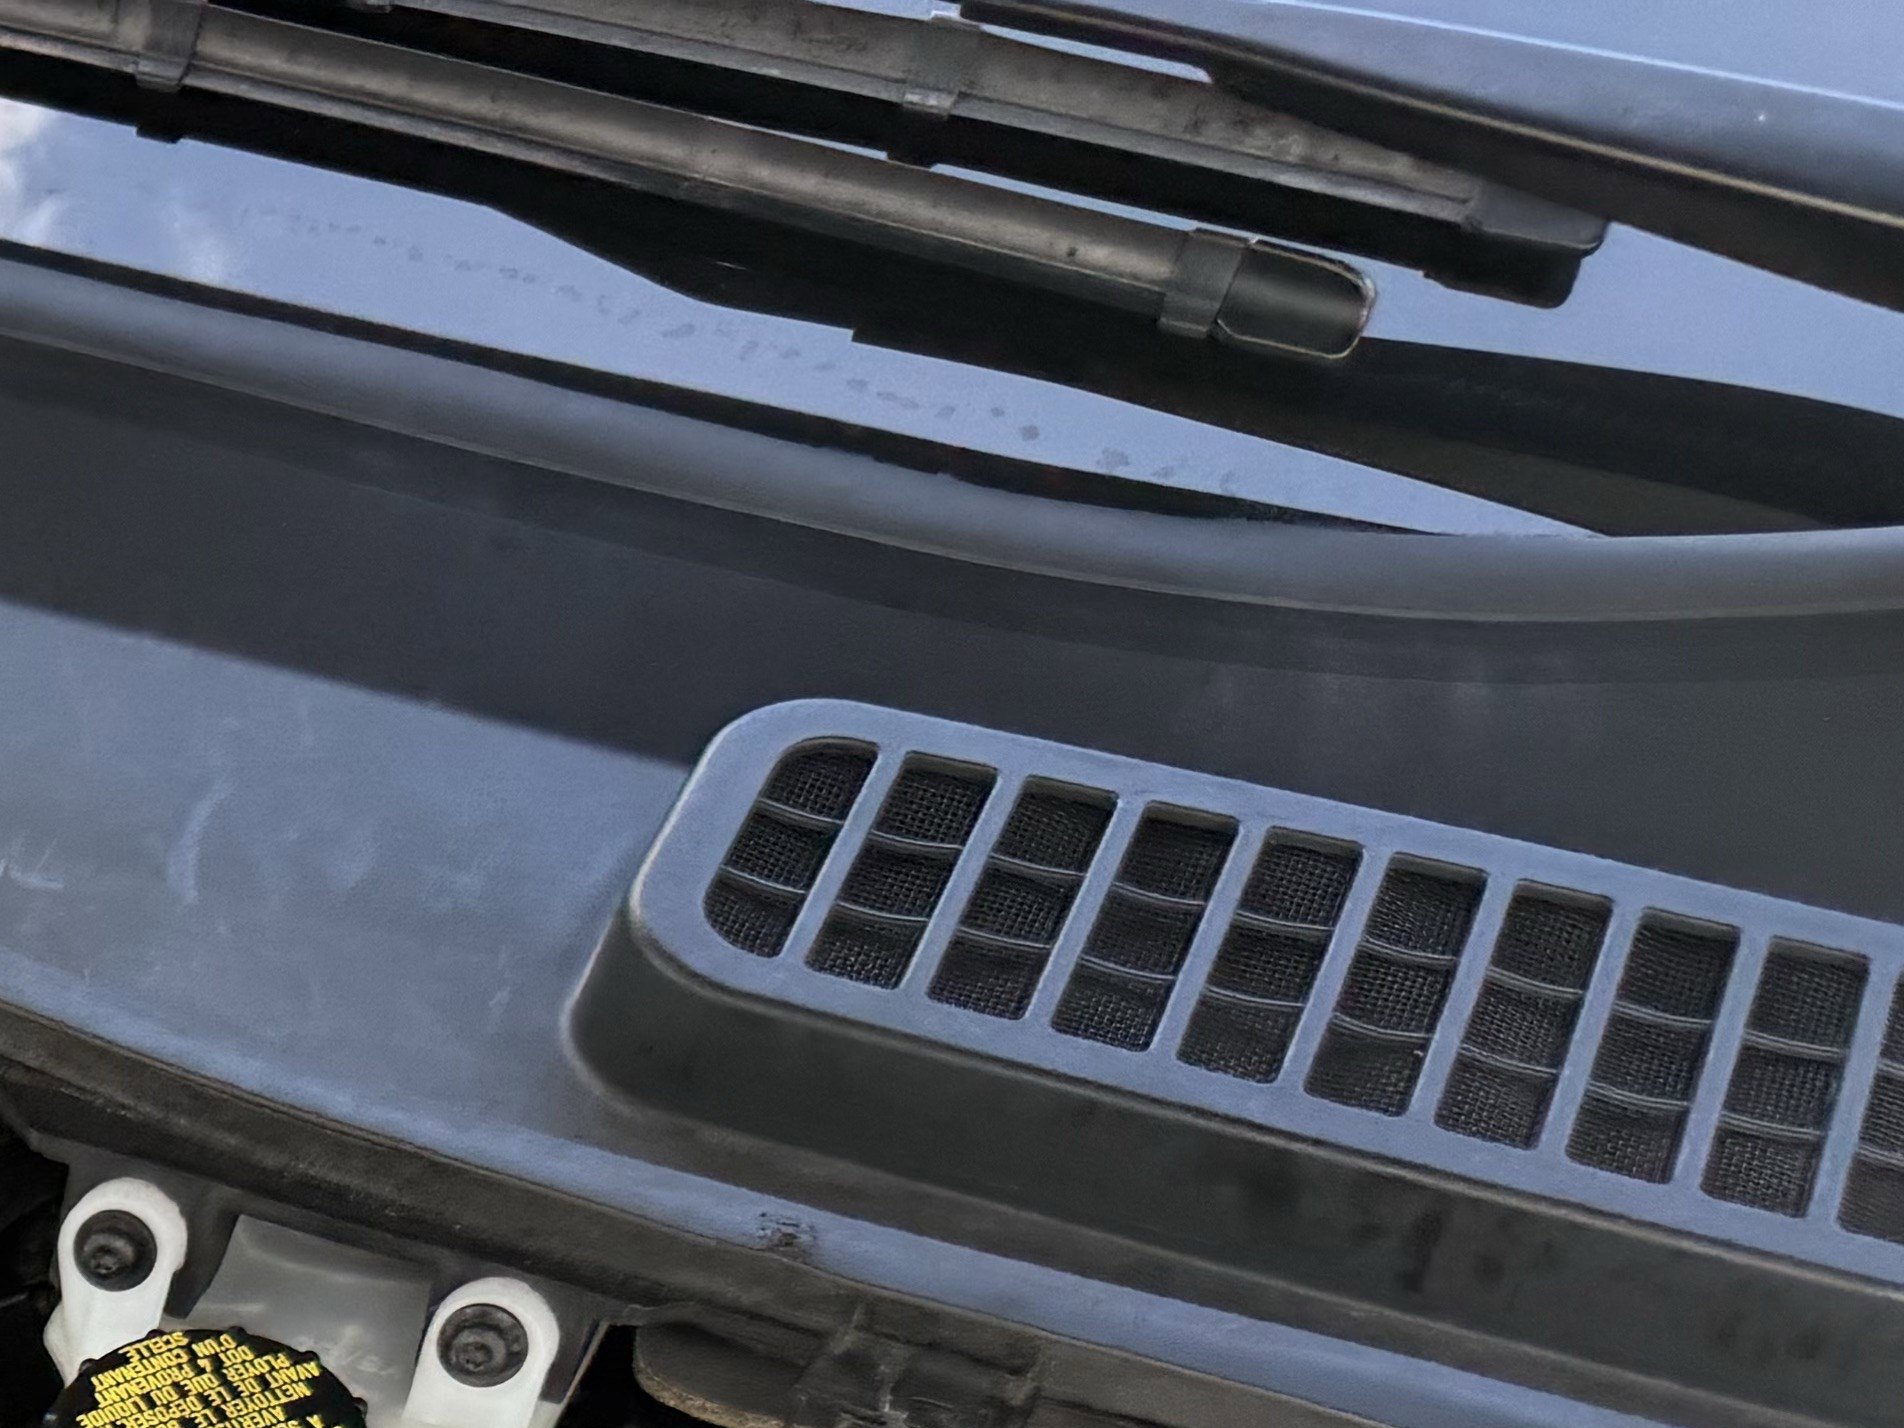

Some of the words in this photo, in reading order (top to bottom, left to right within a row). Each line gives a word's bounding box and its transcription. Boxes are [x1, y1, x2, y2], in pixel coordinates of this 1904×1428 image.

[192, 1333, 237, 1357] D'UN
[218, 1345, 255, 1366] DOT
[91, 1348, 190, 1392] CONTENANT
[197, 1358, 213, 1372] 4
[222, 1353, 290, 1381] PLOYER
[265, 1361, 321, 1388] AVANT
[95, 1364, 194, 1408] PROVENANT
[150, 1386, 179, 1406] DU
[180, 1373, 219, 1396] QUE
[232, 1377, 262, 1397] DE
[204, 1387, 231, 1406] LE
[220, 1381, 313, 1417] NETTOYER
